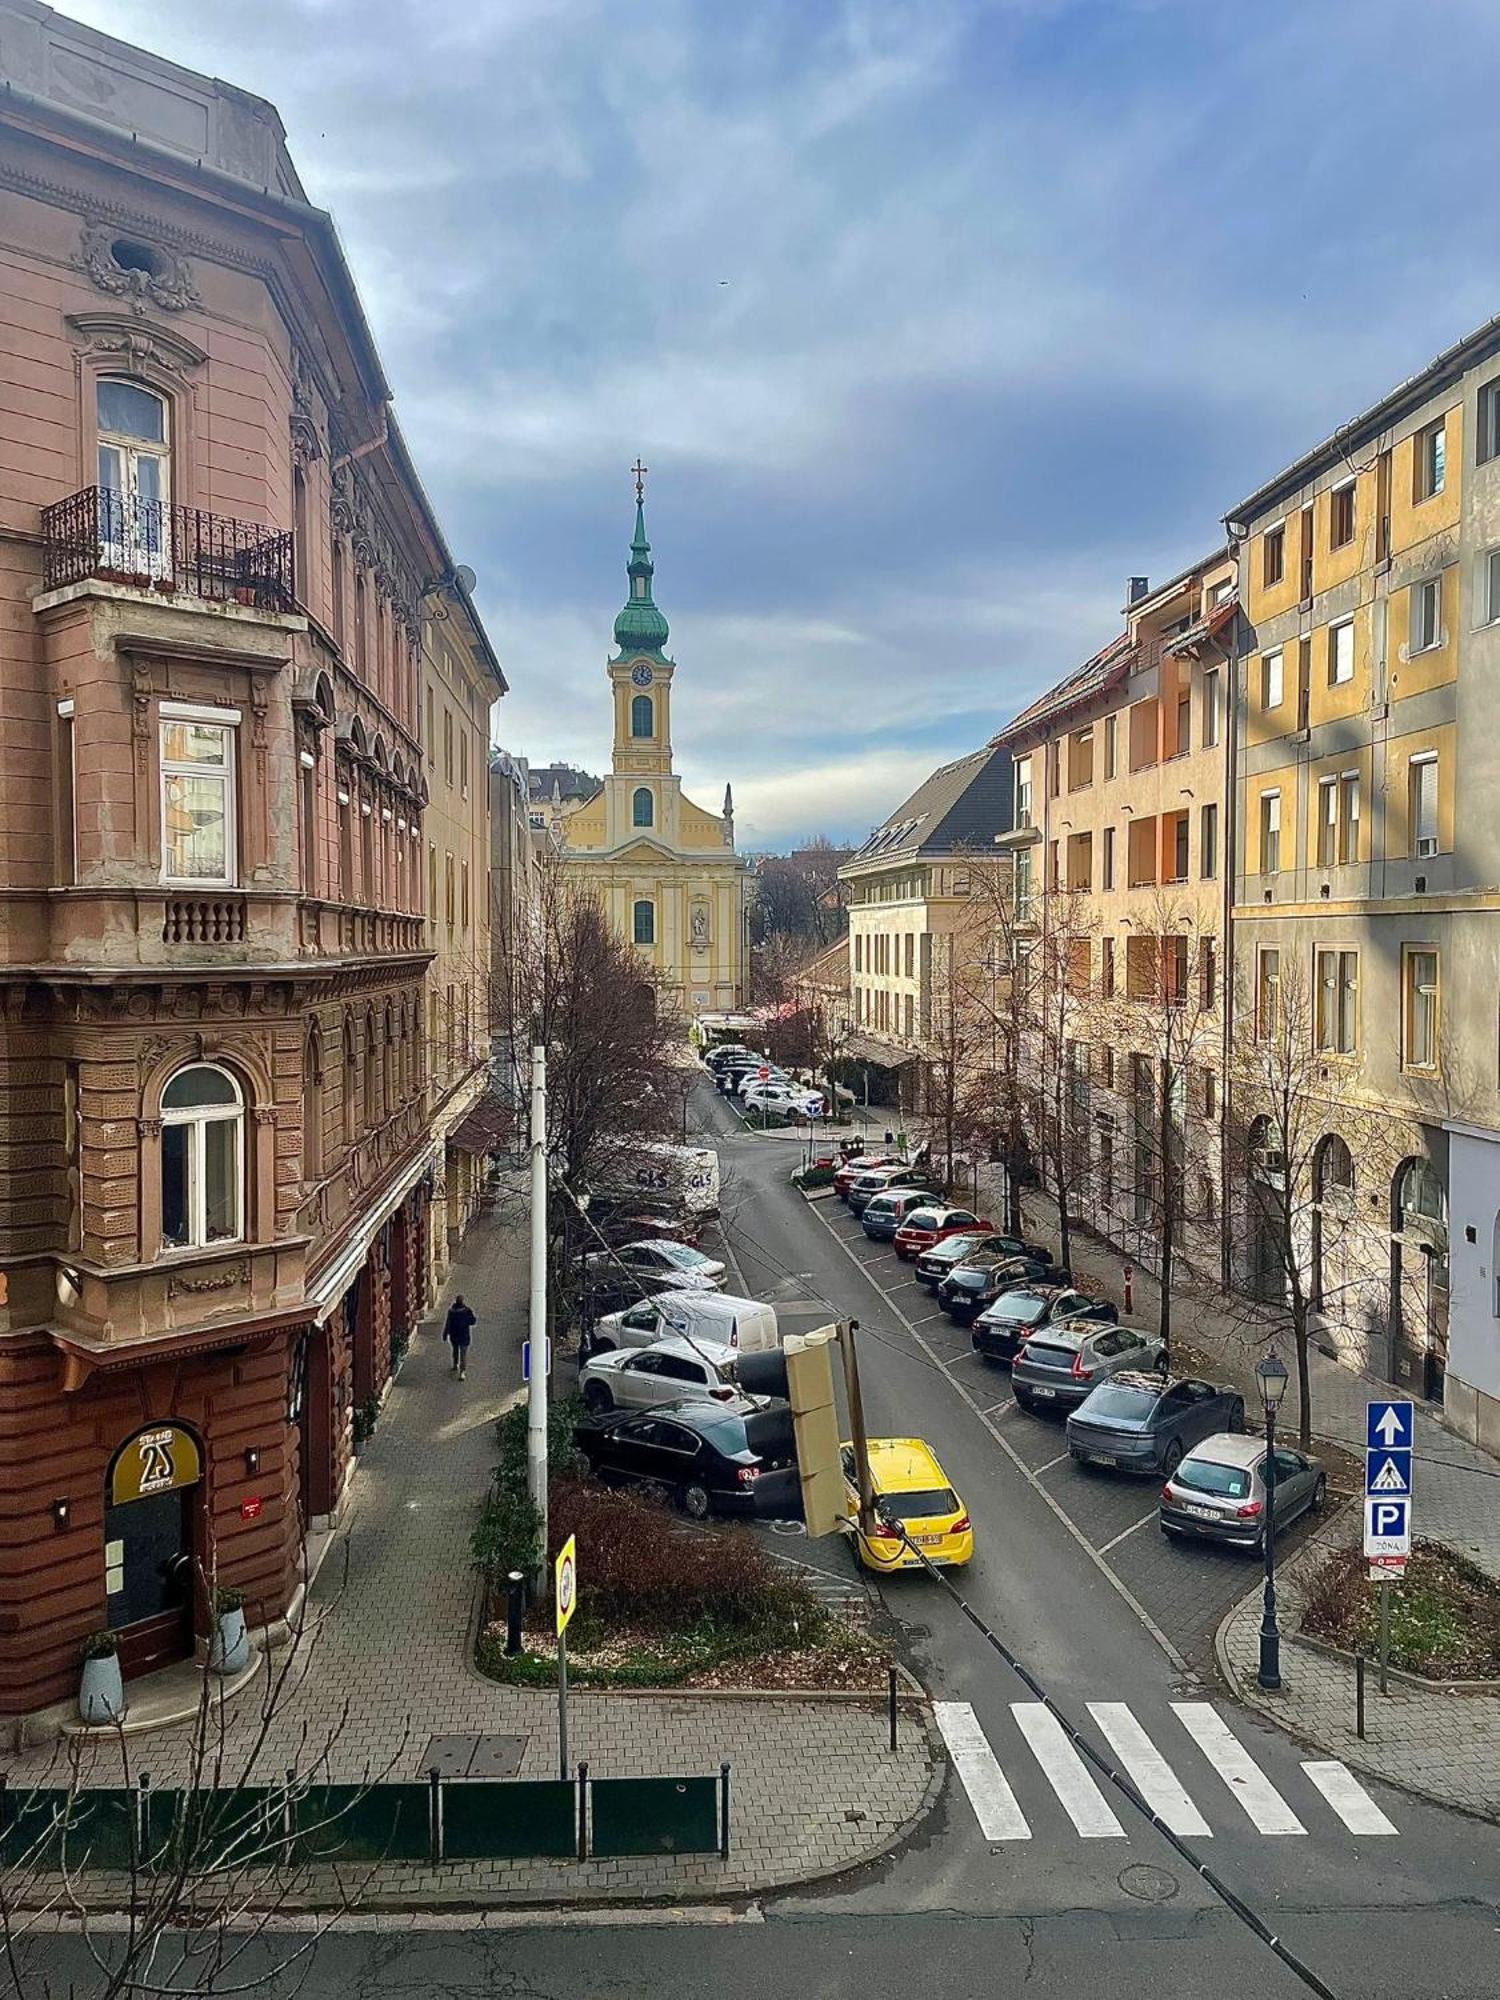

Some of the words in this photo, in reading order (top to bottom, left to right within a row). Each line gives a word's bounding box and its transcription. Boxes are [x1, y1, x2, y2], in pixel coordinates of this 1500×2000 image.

[691, 1174, 712, 1188] GLS
[139, 1439, 176, 1486] 25
[1377, 1505, 1400, 1535] P
